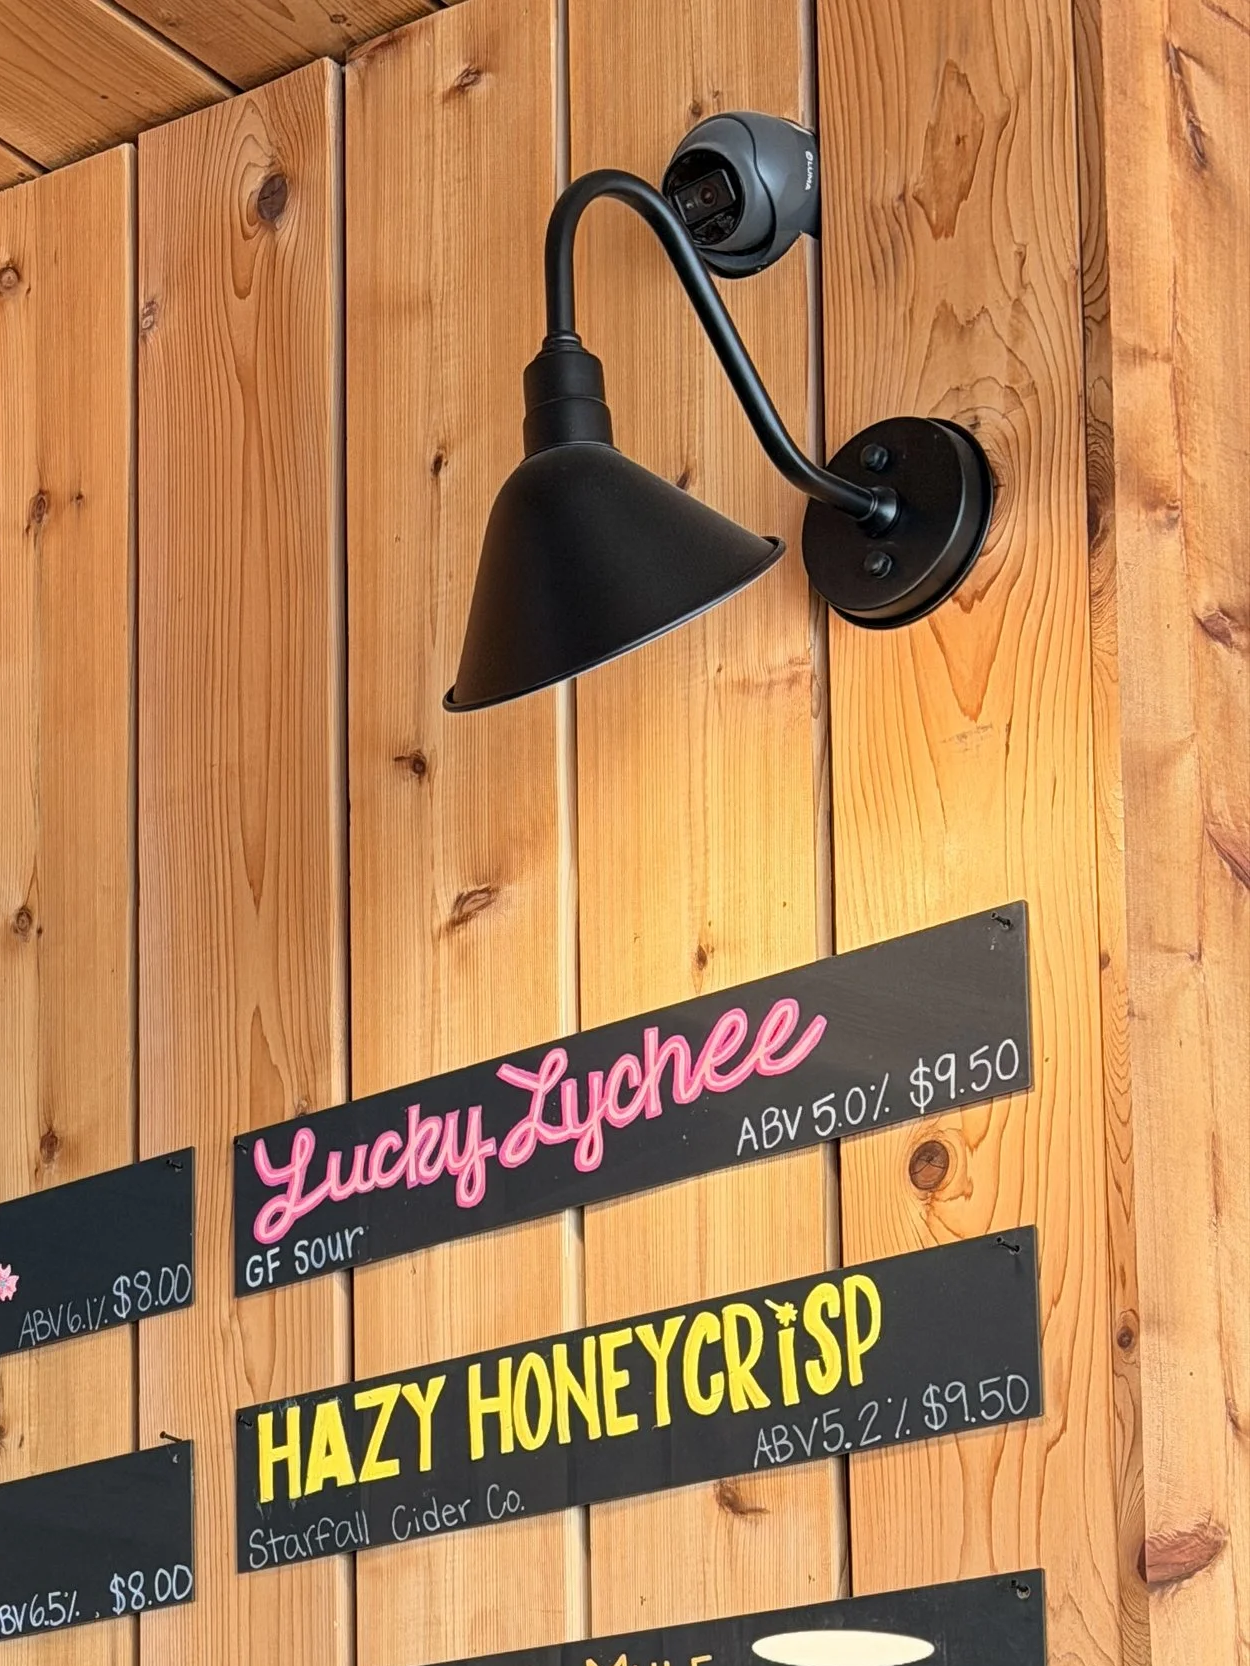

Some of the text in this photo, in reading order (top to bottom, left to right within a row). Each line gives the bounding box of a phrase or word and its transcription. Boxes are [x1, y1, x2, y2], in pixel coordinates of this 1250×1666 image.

[253, 997, 827, 1244] Lucky Lychee
[737, 1039, 1019, 1156] ABV 5.0% $9.50
[18, 1264, 192, 1348] ABV 6.1% $8.00
[245, 1241, 280, 1287] GF
[257, 1374, 447, 1504] HAZY
[753, 1374, 1029, 1468] ABV 5.2% $9.50
[248, 1484, 525, 1570] Starfall Cider Co.
[110, 1565, 193, 1615] $8.00
